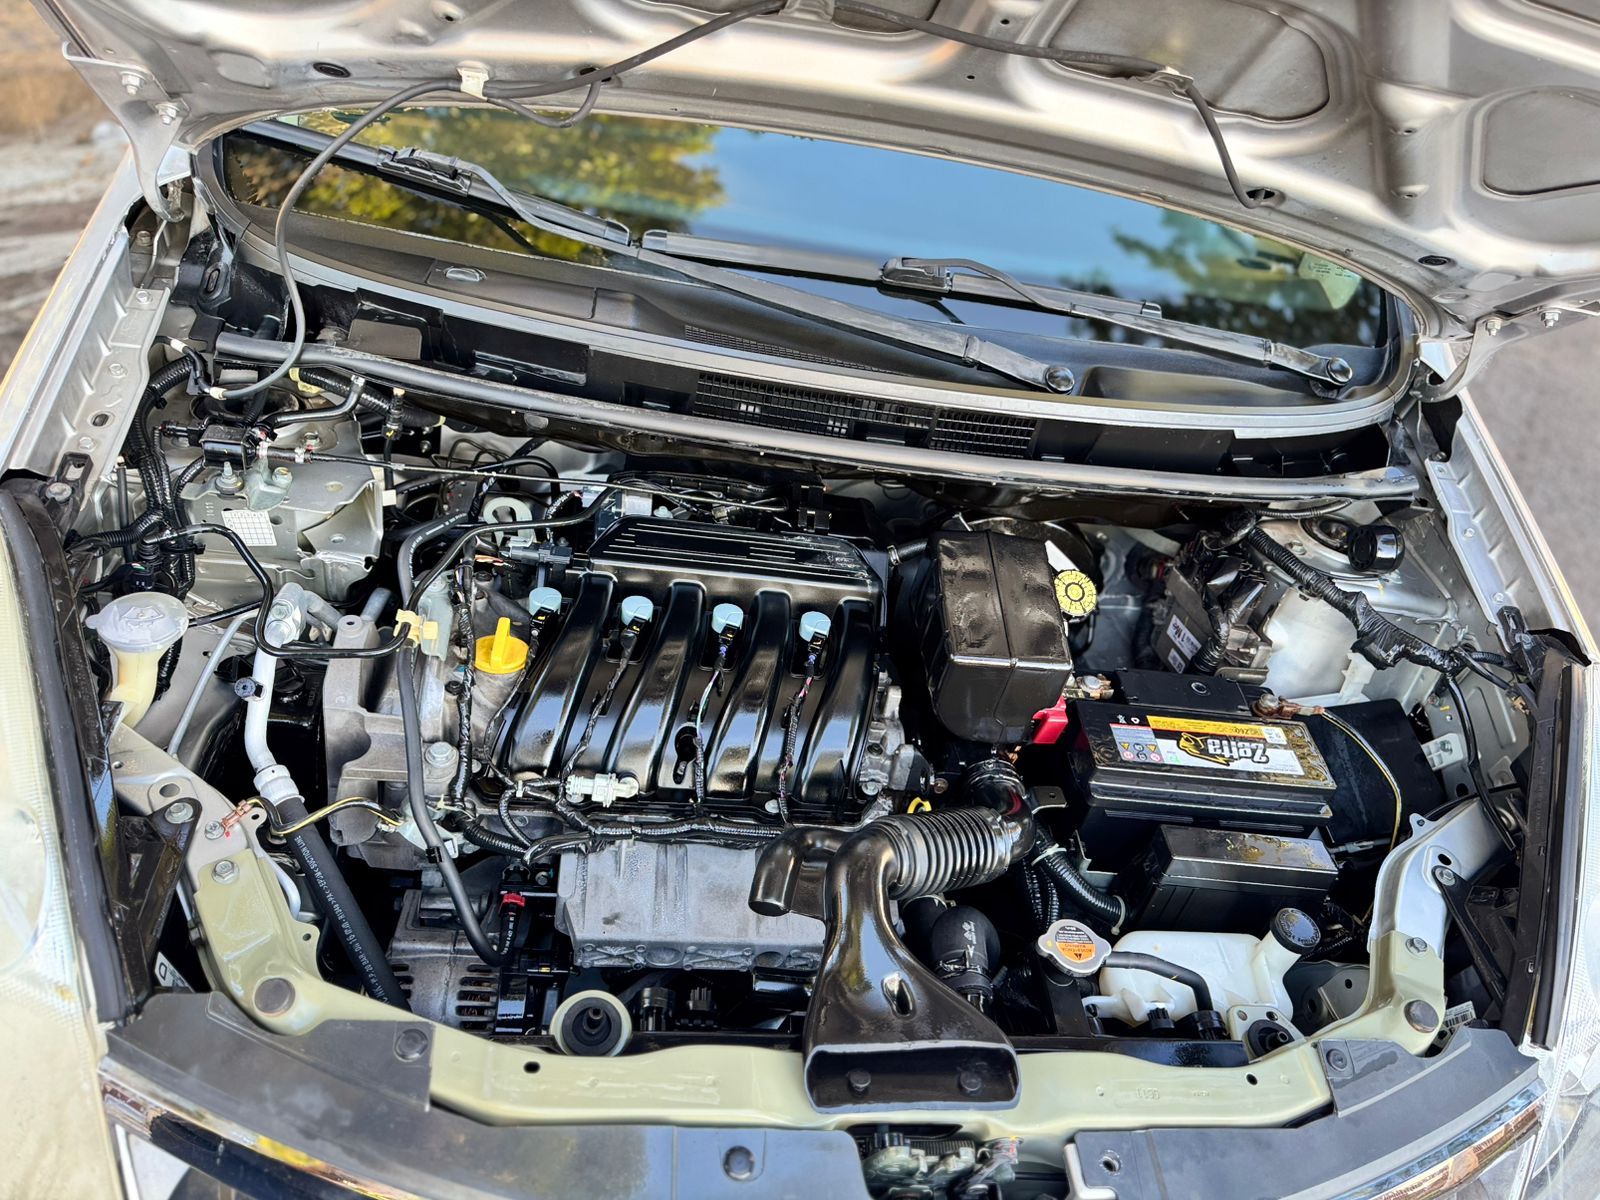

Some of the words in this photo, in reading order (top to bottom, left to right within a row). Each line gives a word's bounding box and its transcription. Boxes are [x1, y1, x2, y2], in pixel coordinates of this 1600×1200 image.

[1206, 737, 1268, 763] Zetta
[294, 835, 306, 847] LINE
[301, 846, 318, 869] SUCTION
